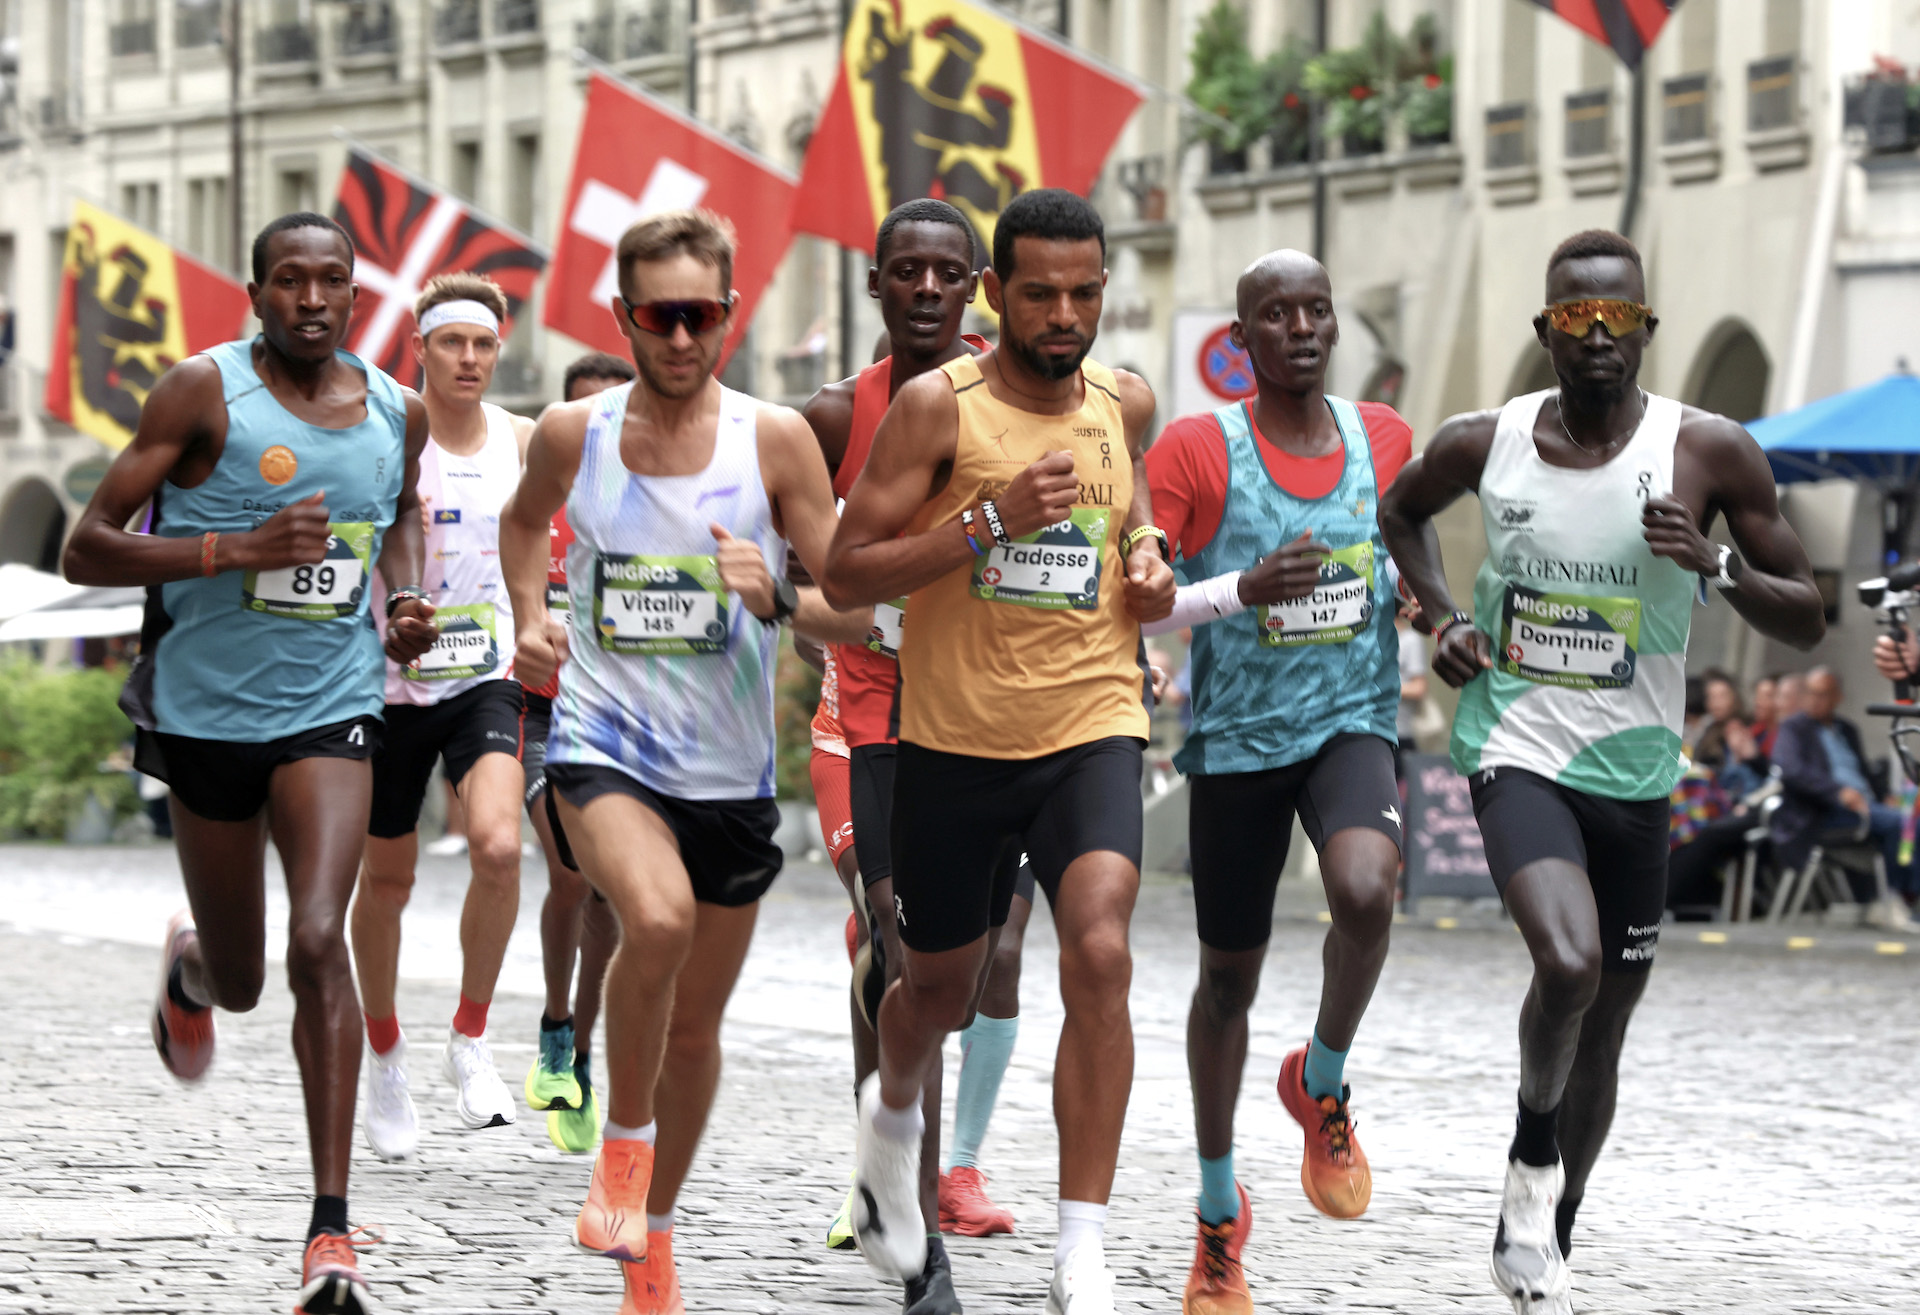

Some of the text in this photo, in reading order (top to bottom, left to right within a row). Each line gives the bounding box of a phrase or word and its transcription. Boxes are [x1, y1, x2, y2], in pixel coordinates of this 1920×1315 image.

[1077, 483, 1113, 505] RALI
[1001, 545, 1088, 567] Tadesse
[292, 565, 335, 595] 89
[603, 562, 679, 583] MIGROS
[1040, 571, 1050, 586] 2
[1527, 557, 1639, 586] GENERALI
[621, 591, 695, 618] Vitaliy
[1513, 592, 1590, 623] MIGROS
[643, 617, 675, 632] 145
[1311, 608, 1337, 624] 147
[431, 632, 485, 649] atthias
[1520, 624, 1614, 653] Dominic
[1562, 651, 1569, 667] 1
